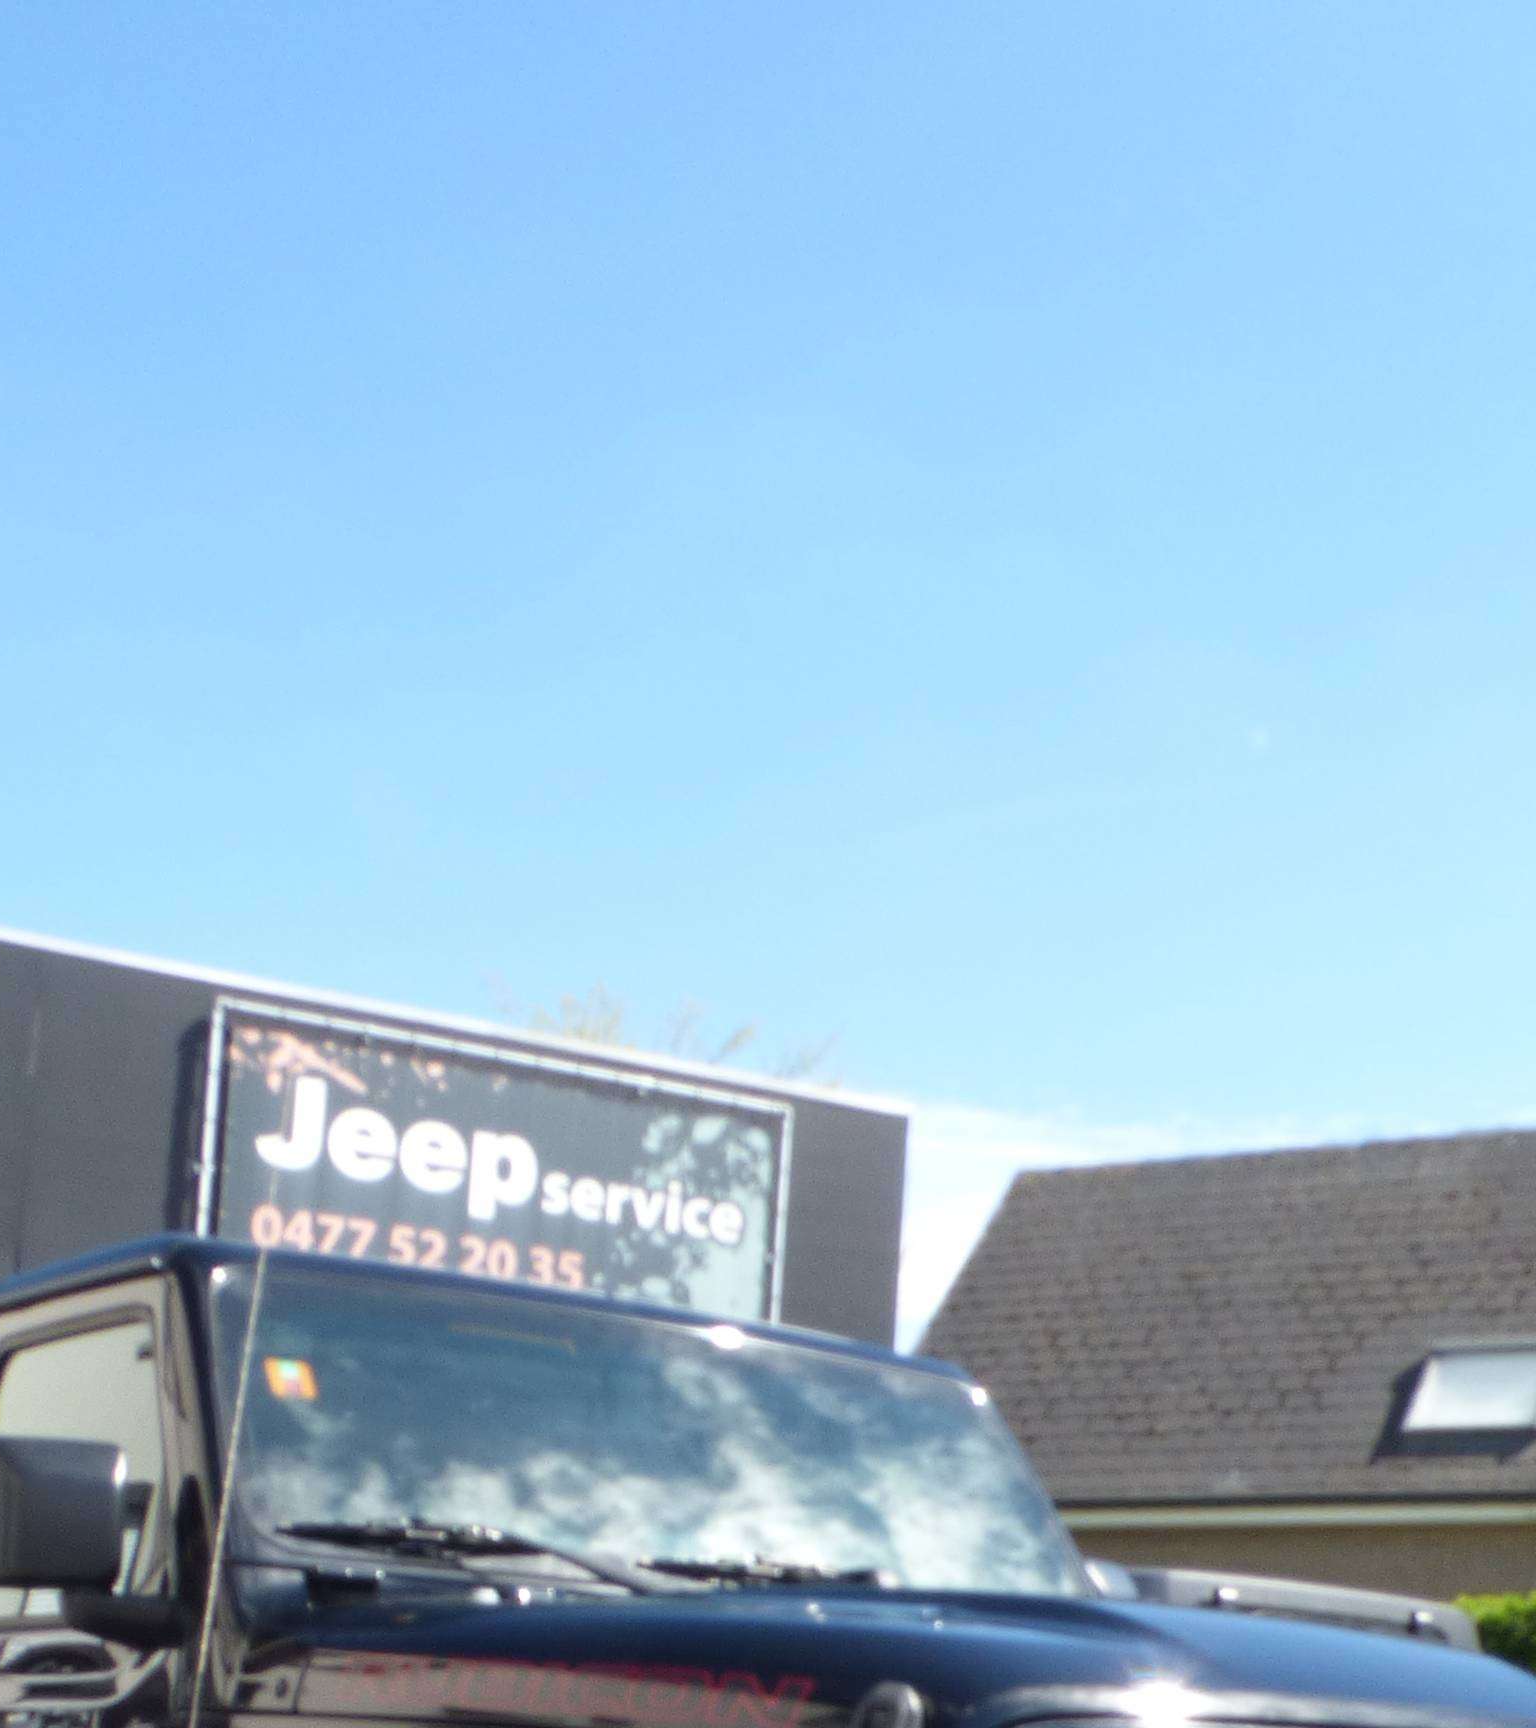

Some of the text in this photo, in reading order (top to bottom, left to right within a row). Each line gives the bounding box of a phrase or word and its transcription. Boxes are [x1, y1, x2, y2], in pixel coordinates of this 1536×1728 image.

[254, 1077, 744, 1245] Jeep service
[251, 1204, 585, 1288] 0477 52 20 35
